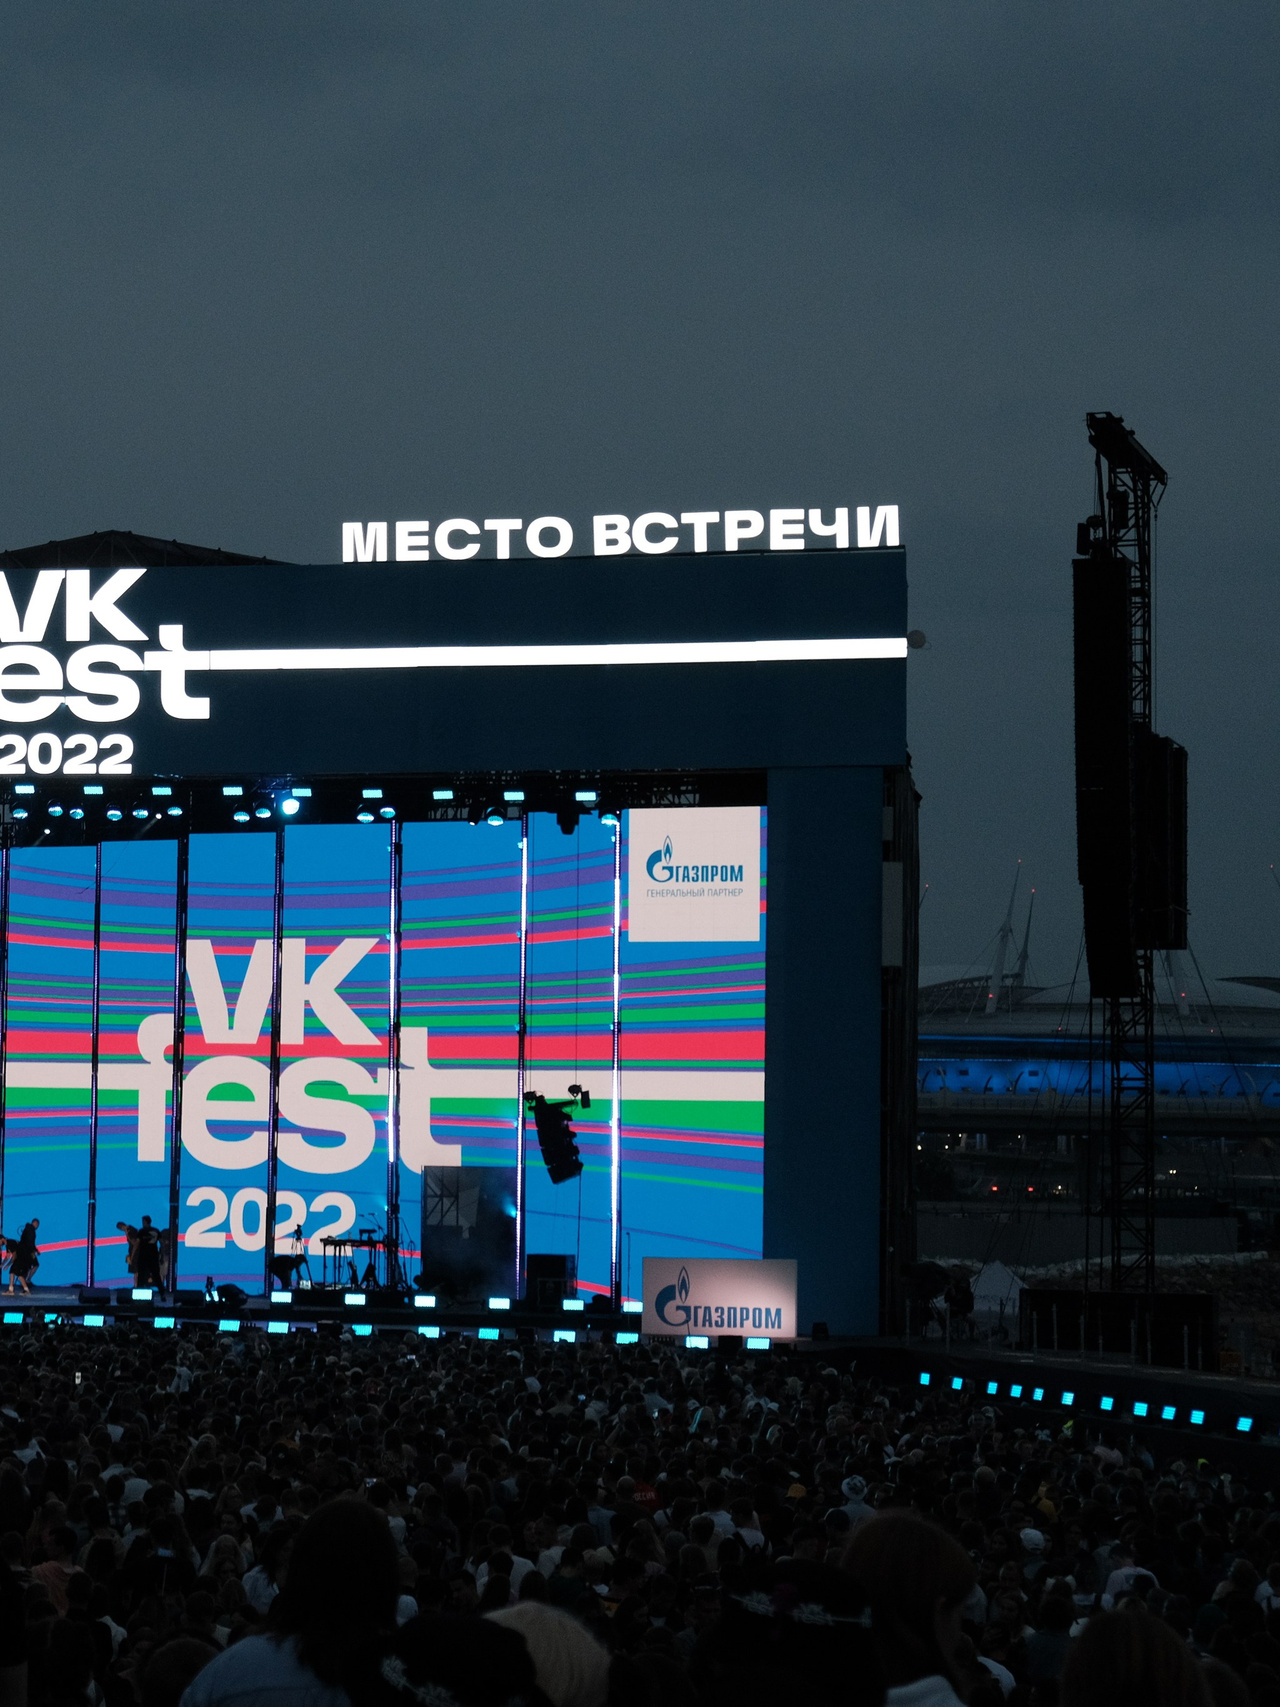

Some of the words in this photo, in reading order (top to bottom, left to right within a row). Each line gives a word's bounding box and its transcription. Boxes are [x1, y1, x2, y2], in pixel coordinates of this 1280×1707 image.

[342, 516, 573, 563] МЕСТО
[593, 504, 900, 556] ВСТРЕЧИ
[646, 887, 705, 898] ГЕНЕРАЛЬНЫЙ
[707, 888, 744, 897] ПАРТНЕР
[674, 864, 744, 883] ГАЗПРОМ
[185, 938, 383, 1046] VK
[137, 1013, 462, 1174] fest
[185, 1186, 356, 1257] 2022
[693, 1305, 782, 1329] ГАЗПРОМ
